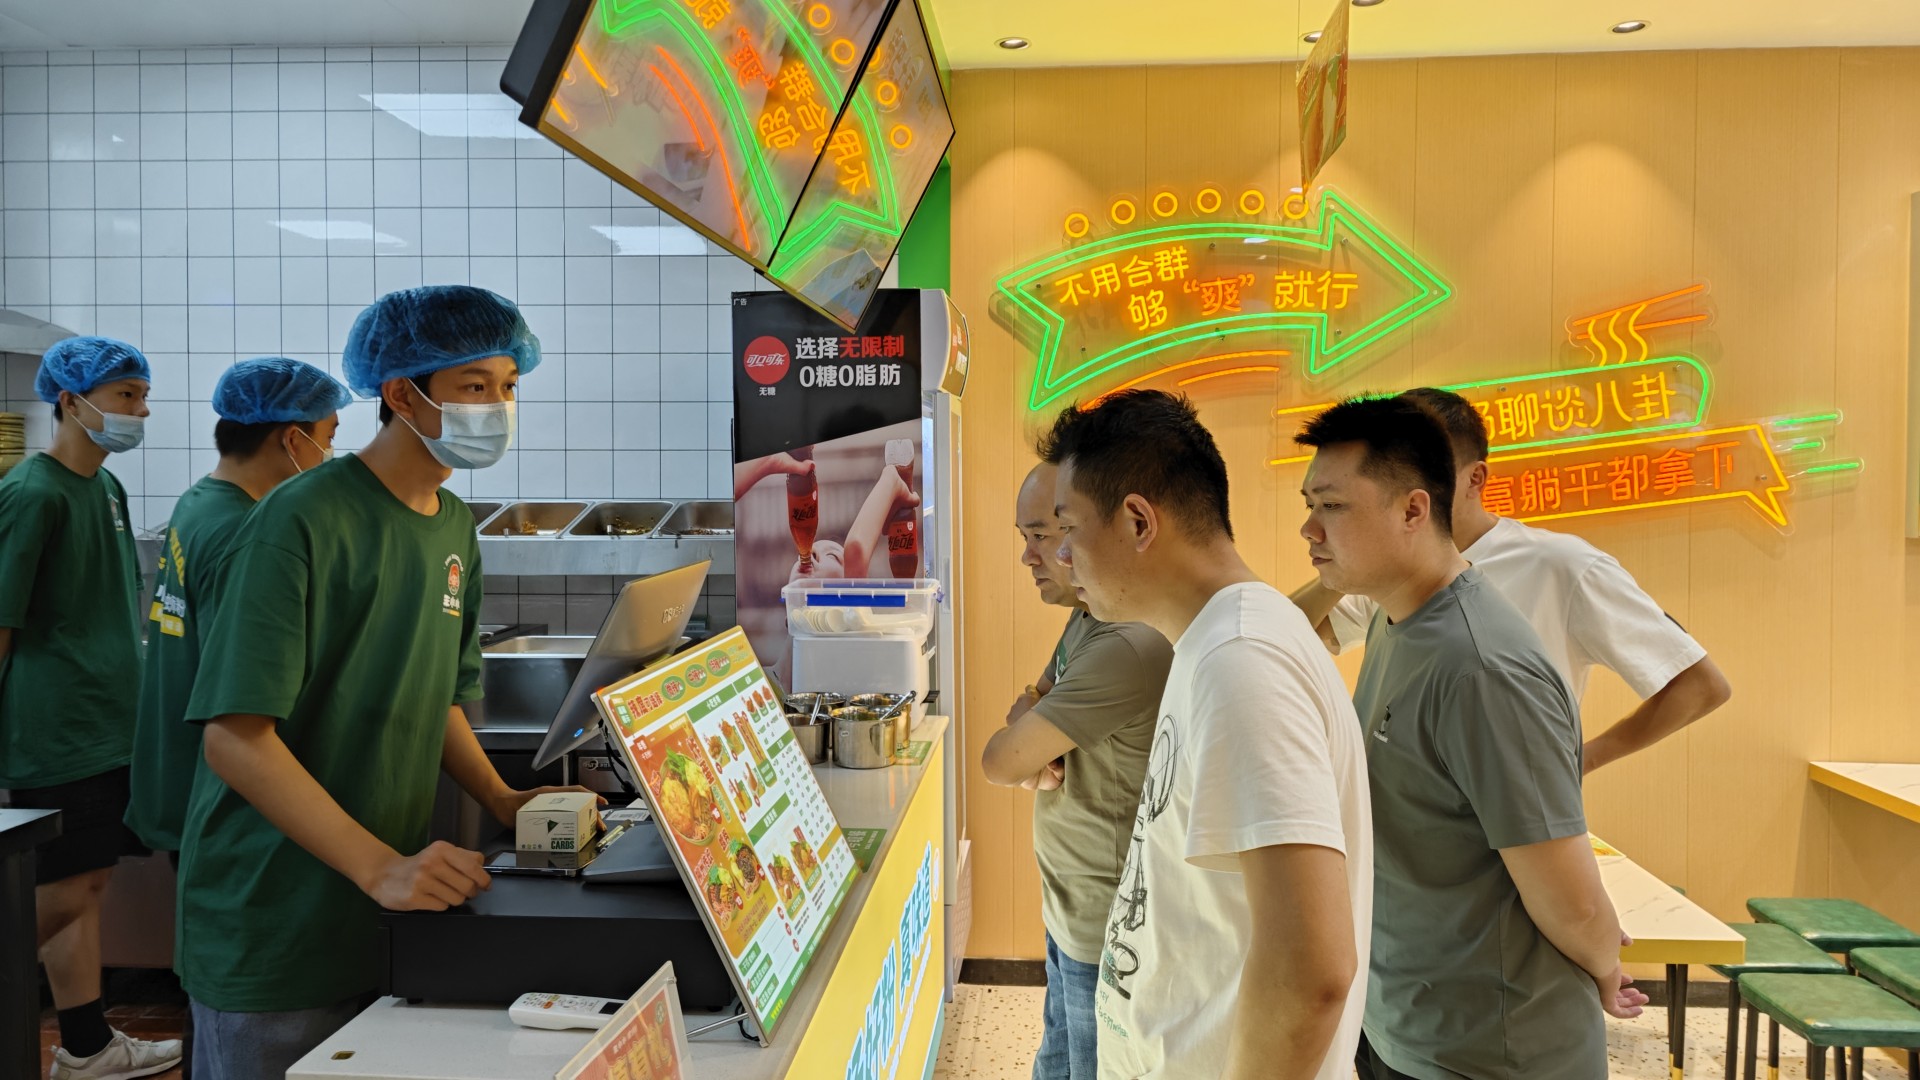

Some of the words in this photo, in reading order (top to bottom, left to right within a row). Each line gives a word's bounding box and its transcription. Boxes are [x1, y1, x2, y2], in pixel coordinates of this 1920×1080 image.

[1055, 244, 1190, 308] 不用合群
[733, 297, 747, 307] 广告
[795, 334, 905, 360] 选择无限制
[799, 364, 901, 388] 0糖0脂肪
[758, 386, 776, 397] 无糖
[551, 840, 575, 850] CARDS
